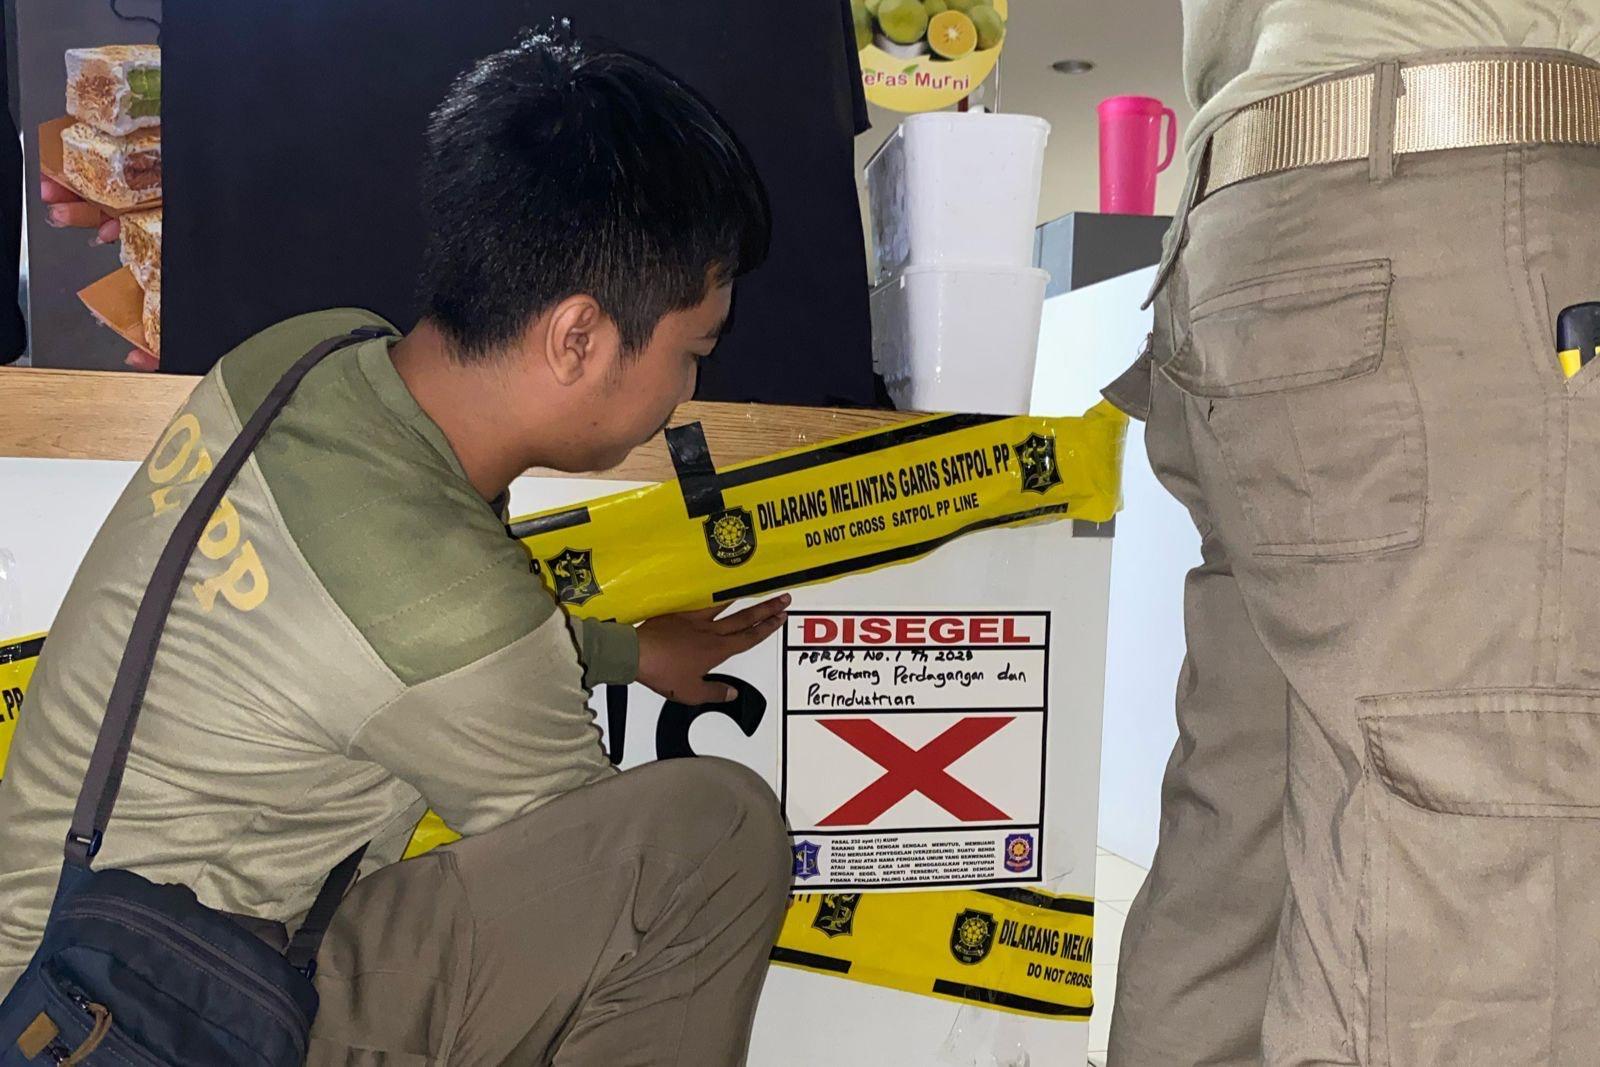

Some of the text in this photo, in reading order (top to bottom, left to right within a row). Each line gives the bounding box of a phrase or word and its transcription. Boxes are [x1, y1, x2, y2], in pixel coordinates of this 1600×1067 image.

[862, 71, 969, 90] eras Murni
[757, 443, 1009, 531] DILARANG MELINTAS GARIS SATPOL PP
[805, 493, 979, 548] DO NOT CROSS SATPOL PP LINE
[803, 618, 1030, 644] DISEGEL
[798, 651, 855, 665] PERDA
[816, 663, 1027, 688] Tentang Perdagangan dan
[807, 683, 915, 707] Perindustrian
[998, 919, 1059, 956] DILARANG
[1027, 962, 1042, 978] DO
[1044, 967, 1065, 983] NOT
